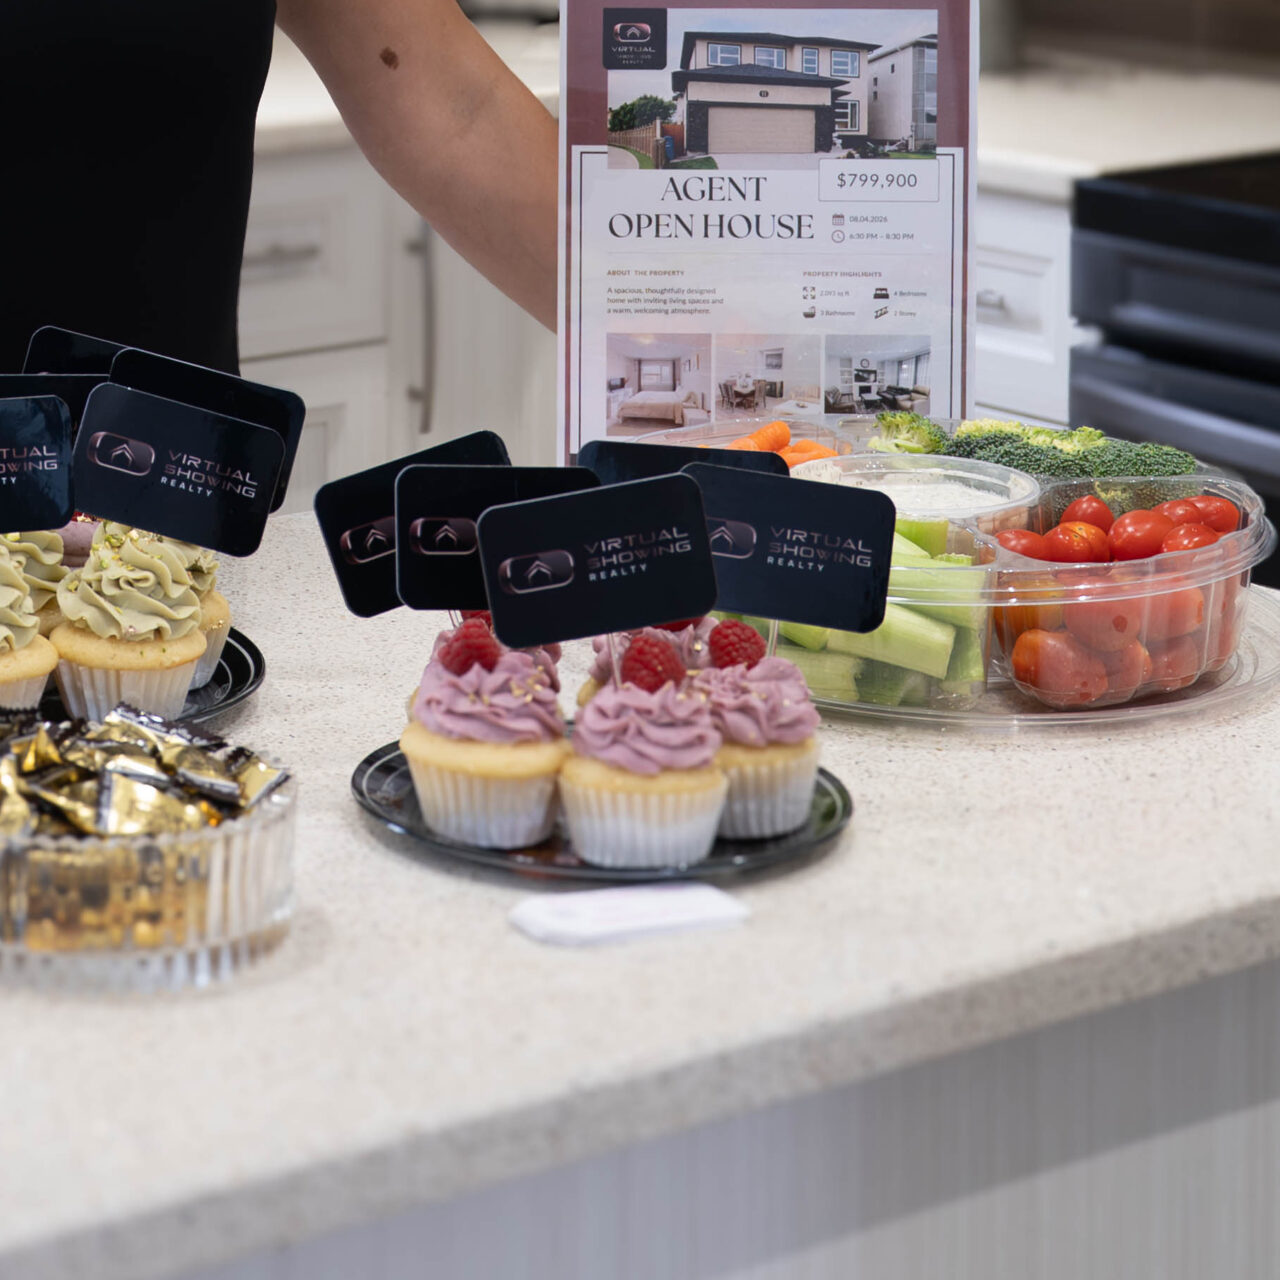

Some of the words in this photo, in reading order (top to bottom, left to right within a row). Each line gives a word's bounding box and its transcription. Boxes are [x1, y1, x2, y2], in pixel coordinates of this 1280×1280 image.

[661, 176, 768, 202] AGENT
[837, 173, 918, 189] $799,900
[608, 213, 694, 239] OPEN
[703, 214, 815, 240] HOUSE
[866, 232, 879, 240] PM
[902, 232, 914, 240] PM
[644, 297, 668, 306] inviting
[669, 297, 687, 306] living
[688, 298, 710, 306] spaces
[645, 287, 685, 296] thoughtfully
[686, 287, 716, 296] designed
[634, 307, 669, 315] welcoming
[168, 449, 258, 486] VIRTUAL
[160, 476, 213, 497] REALTY
[164, 463, 257, 499] SHOWING
[584, 526, 689, 554] VIRTUAL
[770, 526, 873, 553] VIRTUAL
[586, 540, 692, 570] SHOWING
[767, 556, 825, 572] REALTY
[769, 542, 872, 568] SHOWING
[589, 563, 647, 581] REALTY
